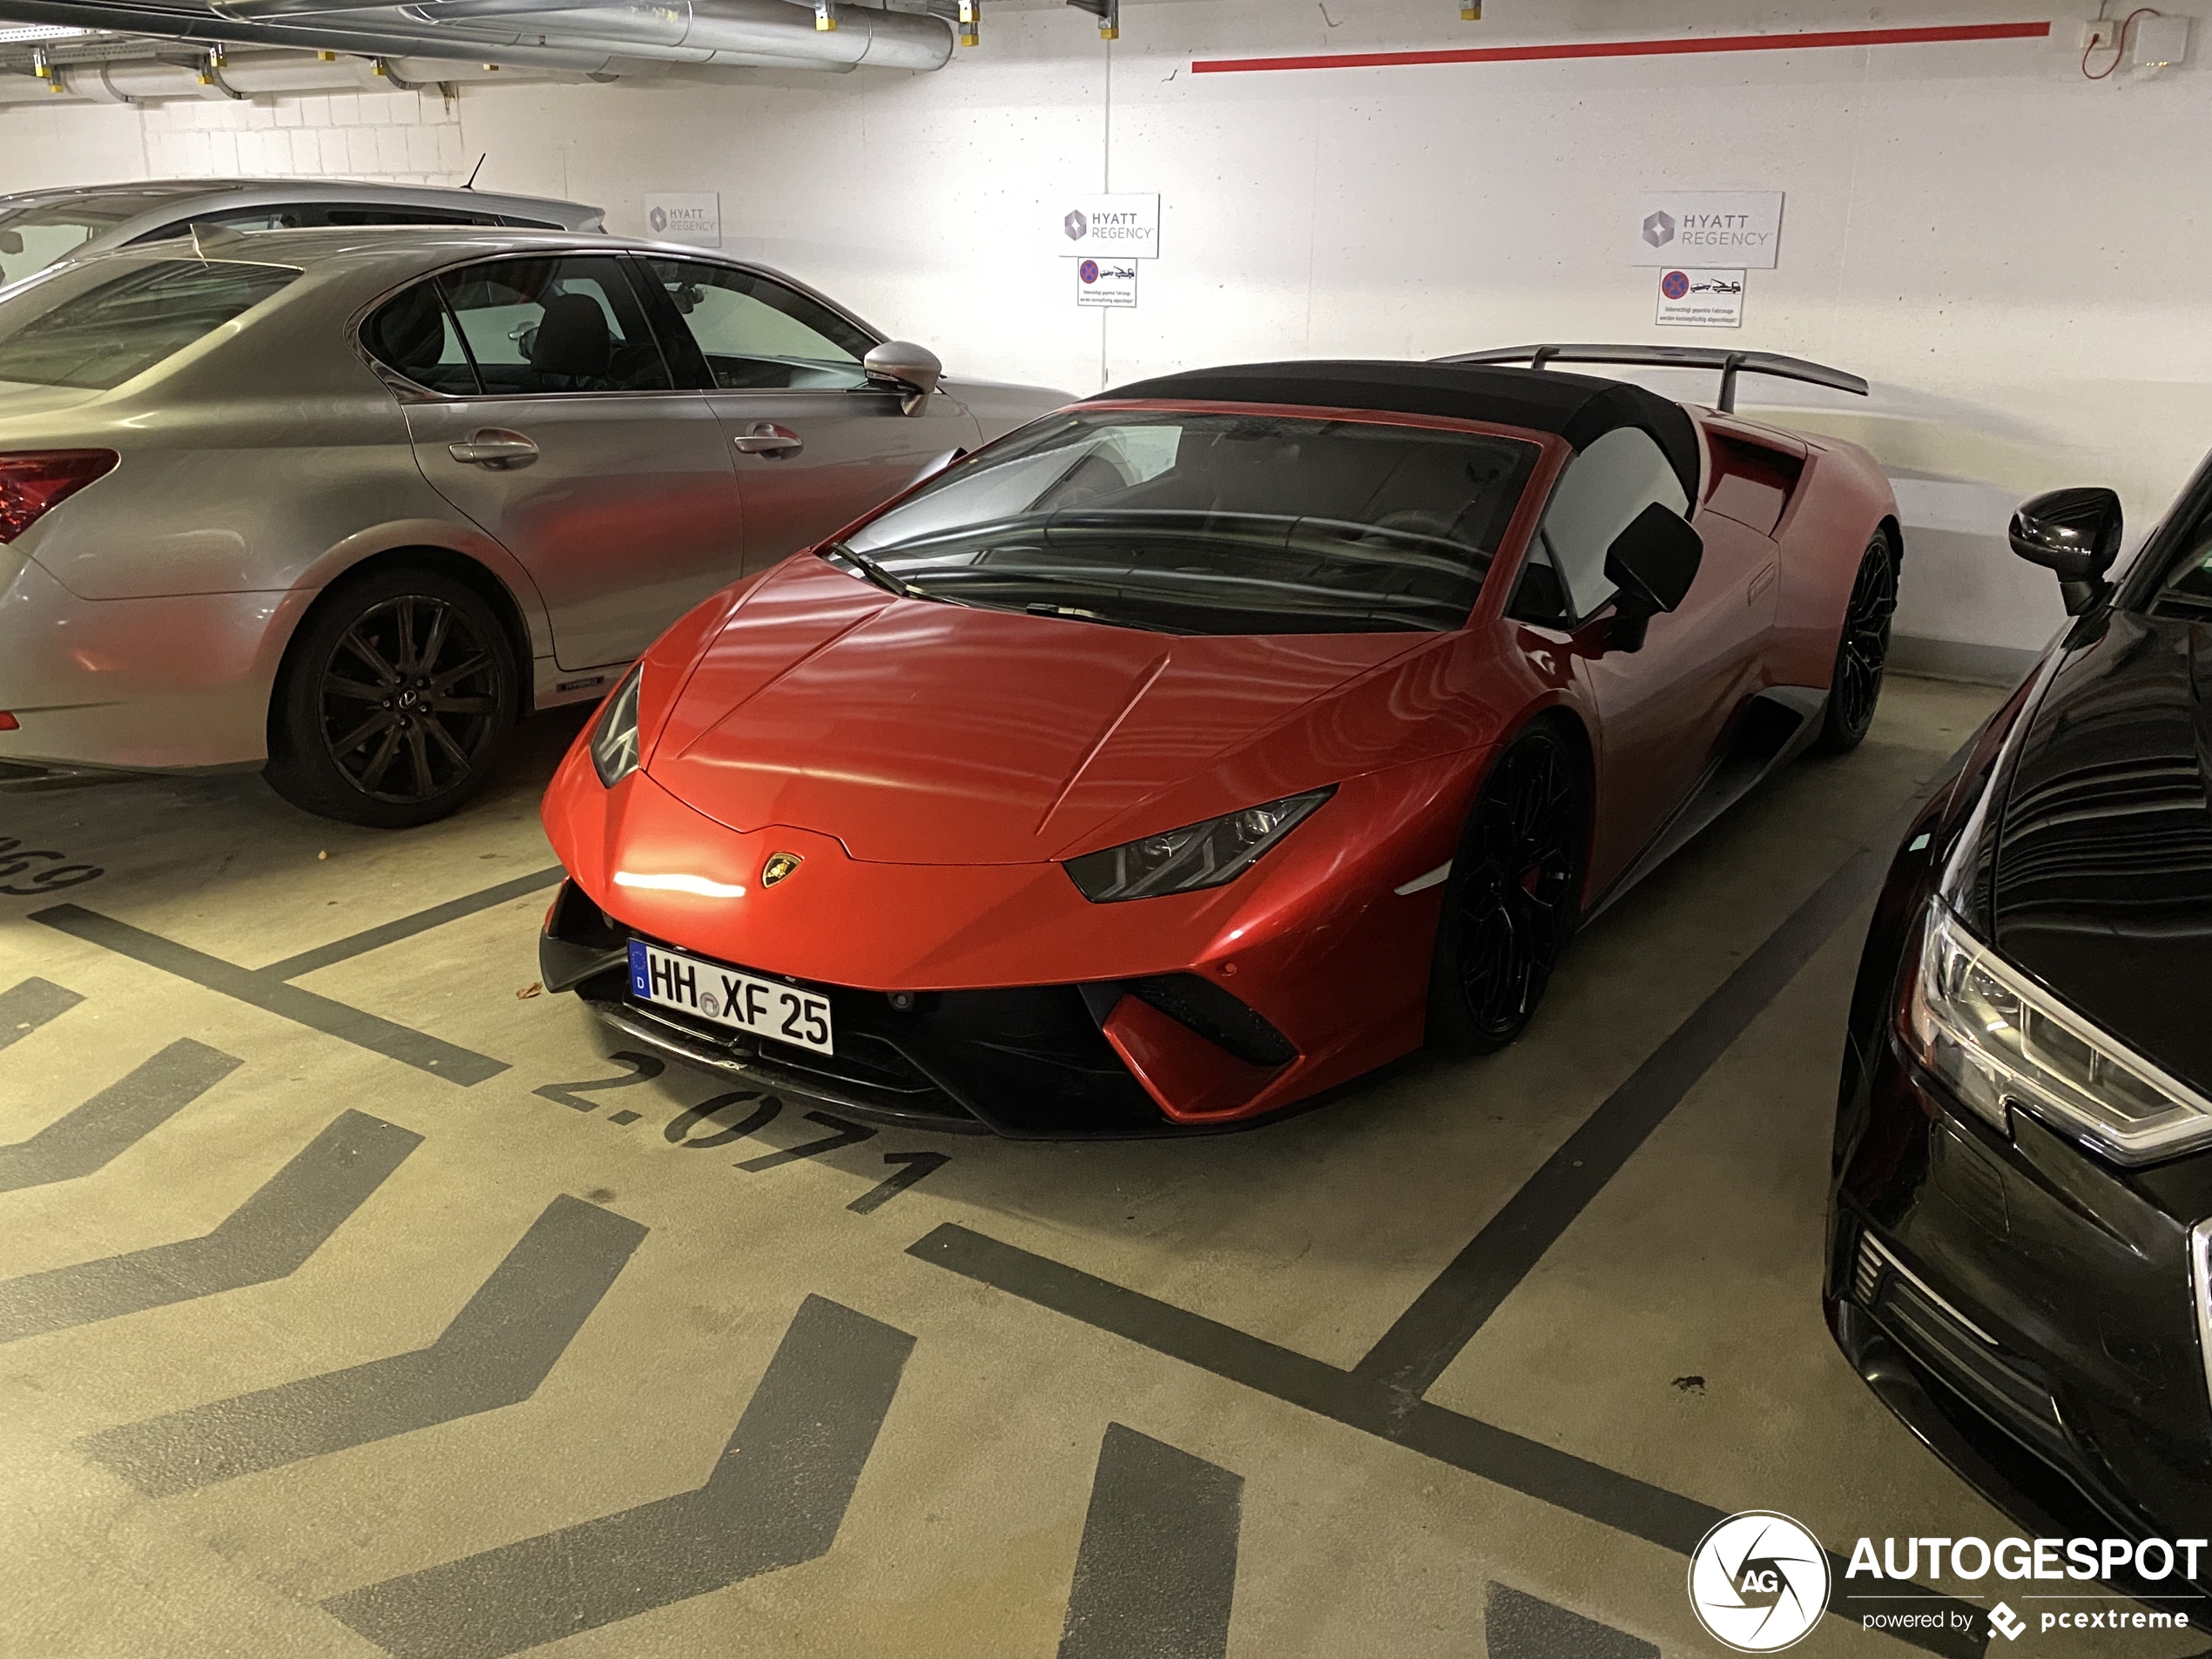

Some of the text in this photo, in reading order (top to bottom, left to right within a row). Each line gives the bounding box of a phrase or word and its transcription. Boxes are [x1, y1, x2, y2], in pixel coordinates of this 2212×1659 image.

[670, 208, 704, 219] HYATT
[1092, 212, 1137, 225] HYATT
[671, 220, 714, 232] REGENCY
[1683, 214, 1749, 228] HYATT
[1092, 227, 1152, 239] REGENCY
[1682, 232, 1769, 246] REGENCY
[637, 954, 827, 1045] D HH XF 25
[530, 1050, 953, 1216] 2.071
